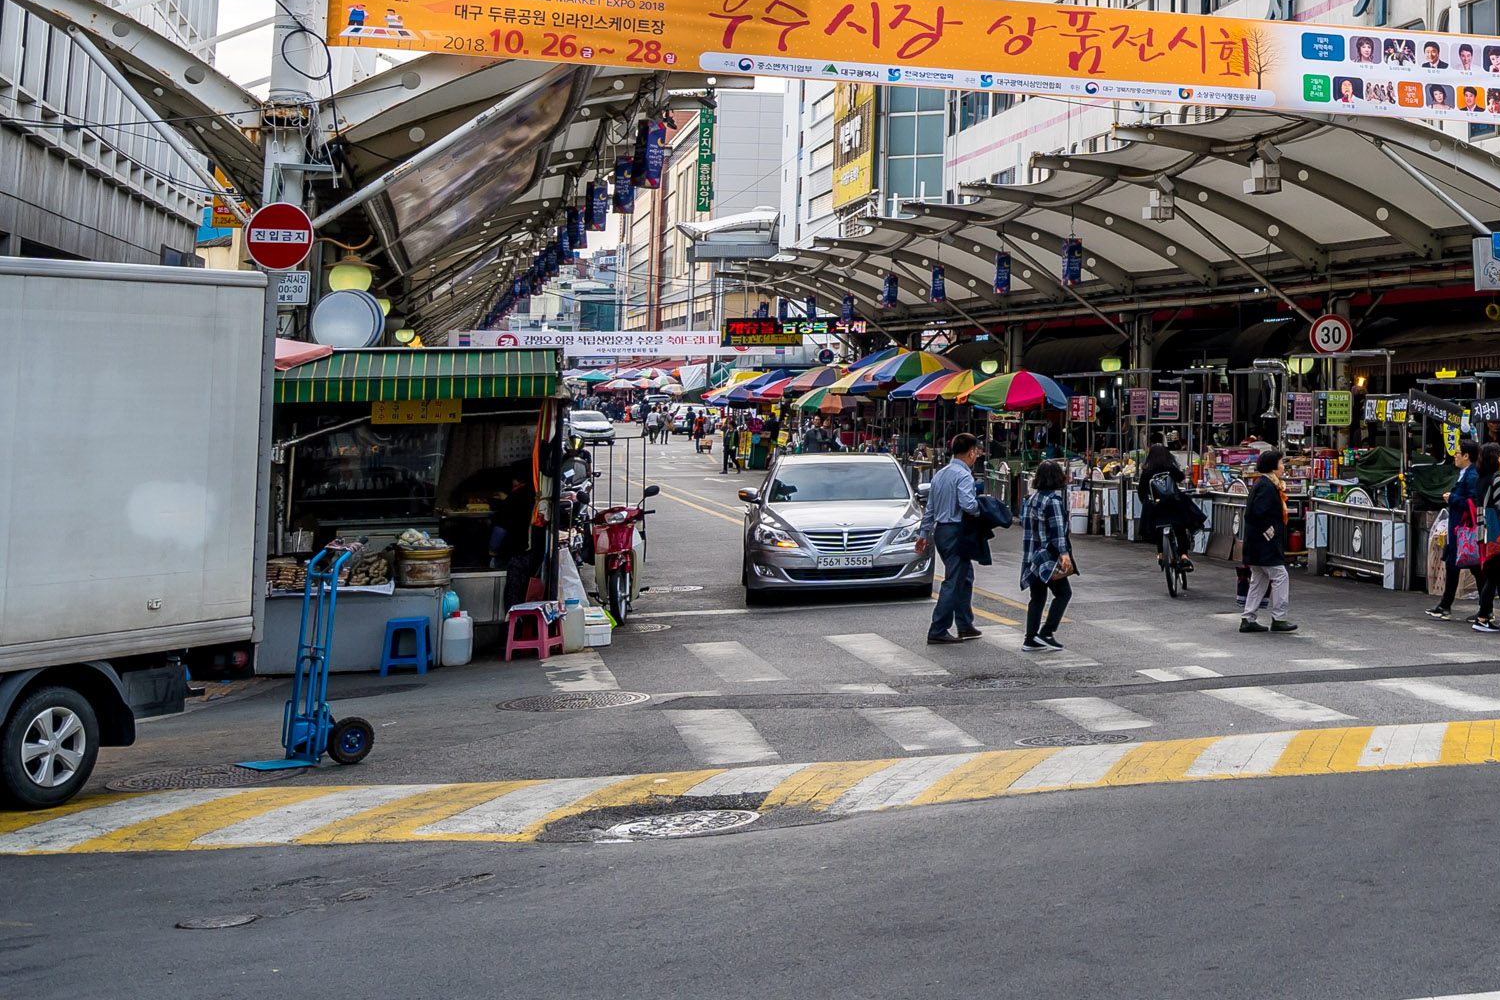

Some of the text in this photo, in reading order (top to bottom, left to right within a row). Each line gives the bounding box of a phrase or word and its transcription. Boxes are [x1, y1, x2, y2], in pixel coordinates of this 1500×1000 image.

[639, 1, 665, 12] 2018
[454, 4, 666, 35] 대구 두류공원 인라인스케이트장
[824, 2, 963, 60] 시장
[986, 10, 1251, 77] 상품전시회
[757, 62, 813, 73] 중소벤처기업부
[840, 68, 879, 79] 대구광역시
[996, 78, 1062, 90] 대구광역시상인연합회
[1196, 90, 1257, 103] 소상공인시장진흥공단
[700, 127, 712, 159] 2지구
[698, 163, 711, 207] 종합상가
[254, 230, 306, 242] 진입금지
[523, 335, 552, 346] 김영오
[554, 335, 574, 346] 회장
[1320, 325, 1343, 345] 30
[1474, 401, 1499, 420] 지팡이
[844, 556, 868, 566] 3558
